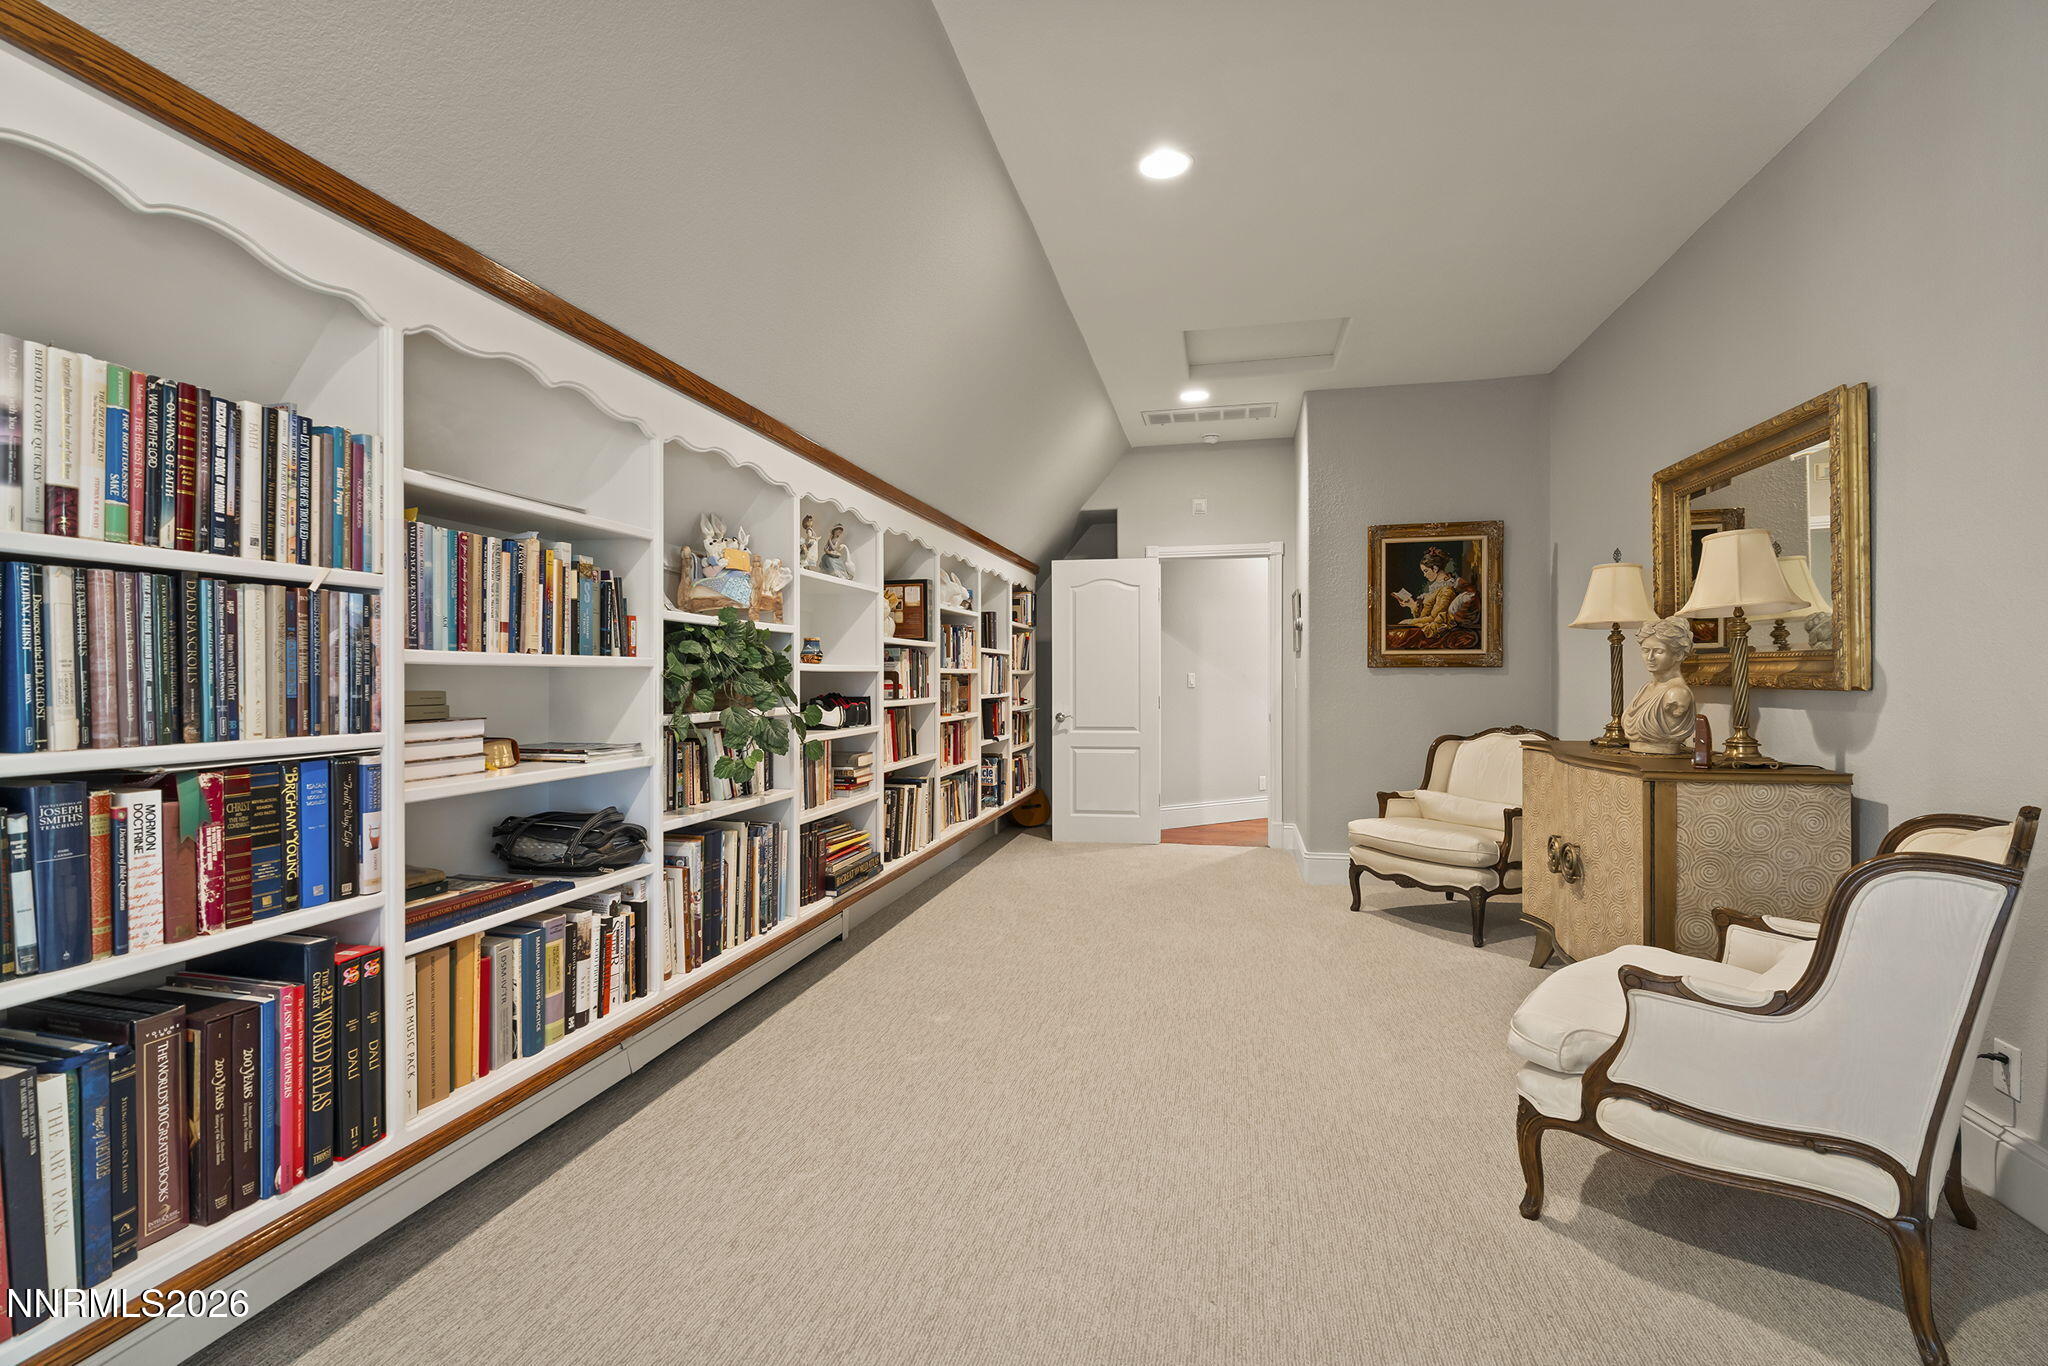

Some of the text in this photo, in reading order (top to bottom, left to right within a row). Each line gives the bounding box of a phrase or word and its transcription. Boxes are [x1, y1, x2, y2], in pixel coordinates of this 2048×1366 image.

[34, 349, 42, 394] BEHOLD,
[8, 416, 17, 429] You
[34, 403, 42, 433] COME
[98, 425, 104, 437] OF
[149, 394, 158, 469] WALK WITH THE LORD
[31, 438, 42, 483] QUICKLY
[134, 433, 142, 465] HIGHEST
[165, 402, 175, 497] ON WINGS OF FAITH
[215, 457, 226, 476] BOOK
[110, 473, 120, 496] SAKE
[134, 478, 142, 488] US
[135, 467, 142, 477] IN
[299, 434, 310, 540] LET NOT YOUR HEART BE TROUBLED
[215, 483, 226, 514] MORMON
[76, 576, 85, 590] THE
[20, 566, 32, 652] FOLLOWING CHRIST
[76, 591, 85, 617] POWER
[186, 580, 197, 684] DEAD SEA SCROLLS
[314, 638, 320, 647] IN
[32, 594, 45, 720] Discourses on the HOLY GHOST
[39, 805, 82, 817] JOSEPH
[40, 813, 83, 825] SMITH'S
[226, 802, 250, 813] CHRIST
[281, 767, 299, 881] BRIGHAM YOUNG
[40, 822, 83, 830] TEACHINGS
[118, 828, 126, 858] Dictionary
[133, 803, 144, 854] DOCTRINE
[146, 804, 156, 851] MORMON
[118, 881, 126, 911] Quotations
[282, 993, 294, 1099] CLASSICAL COMPOSERS
[406, 992, 415, 1079] THE MUSIC PACK
[240, 1048, 254, 1099] 200 YEARS
[312, 1006, 332, 1112] WORLD ATLAS
[211, 1058, 225, 1110] 200 YEARS
[157, 1040, 169, 1202] THE WORLD'S 100 GREATEST BOOKS
[47, 1102, 68, 1236] THE ART PACK
[96, 1139, 110, 1180] NATURE
[121, 1150, 129, 1163] OUR
